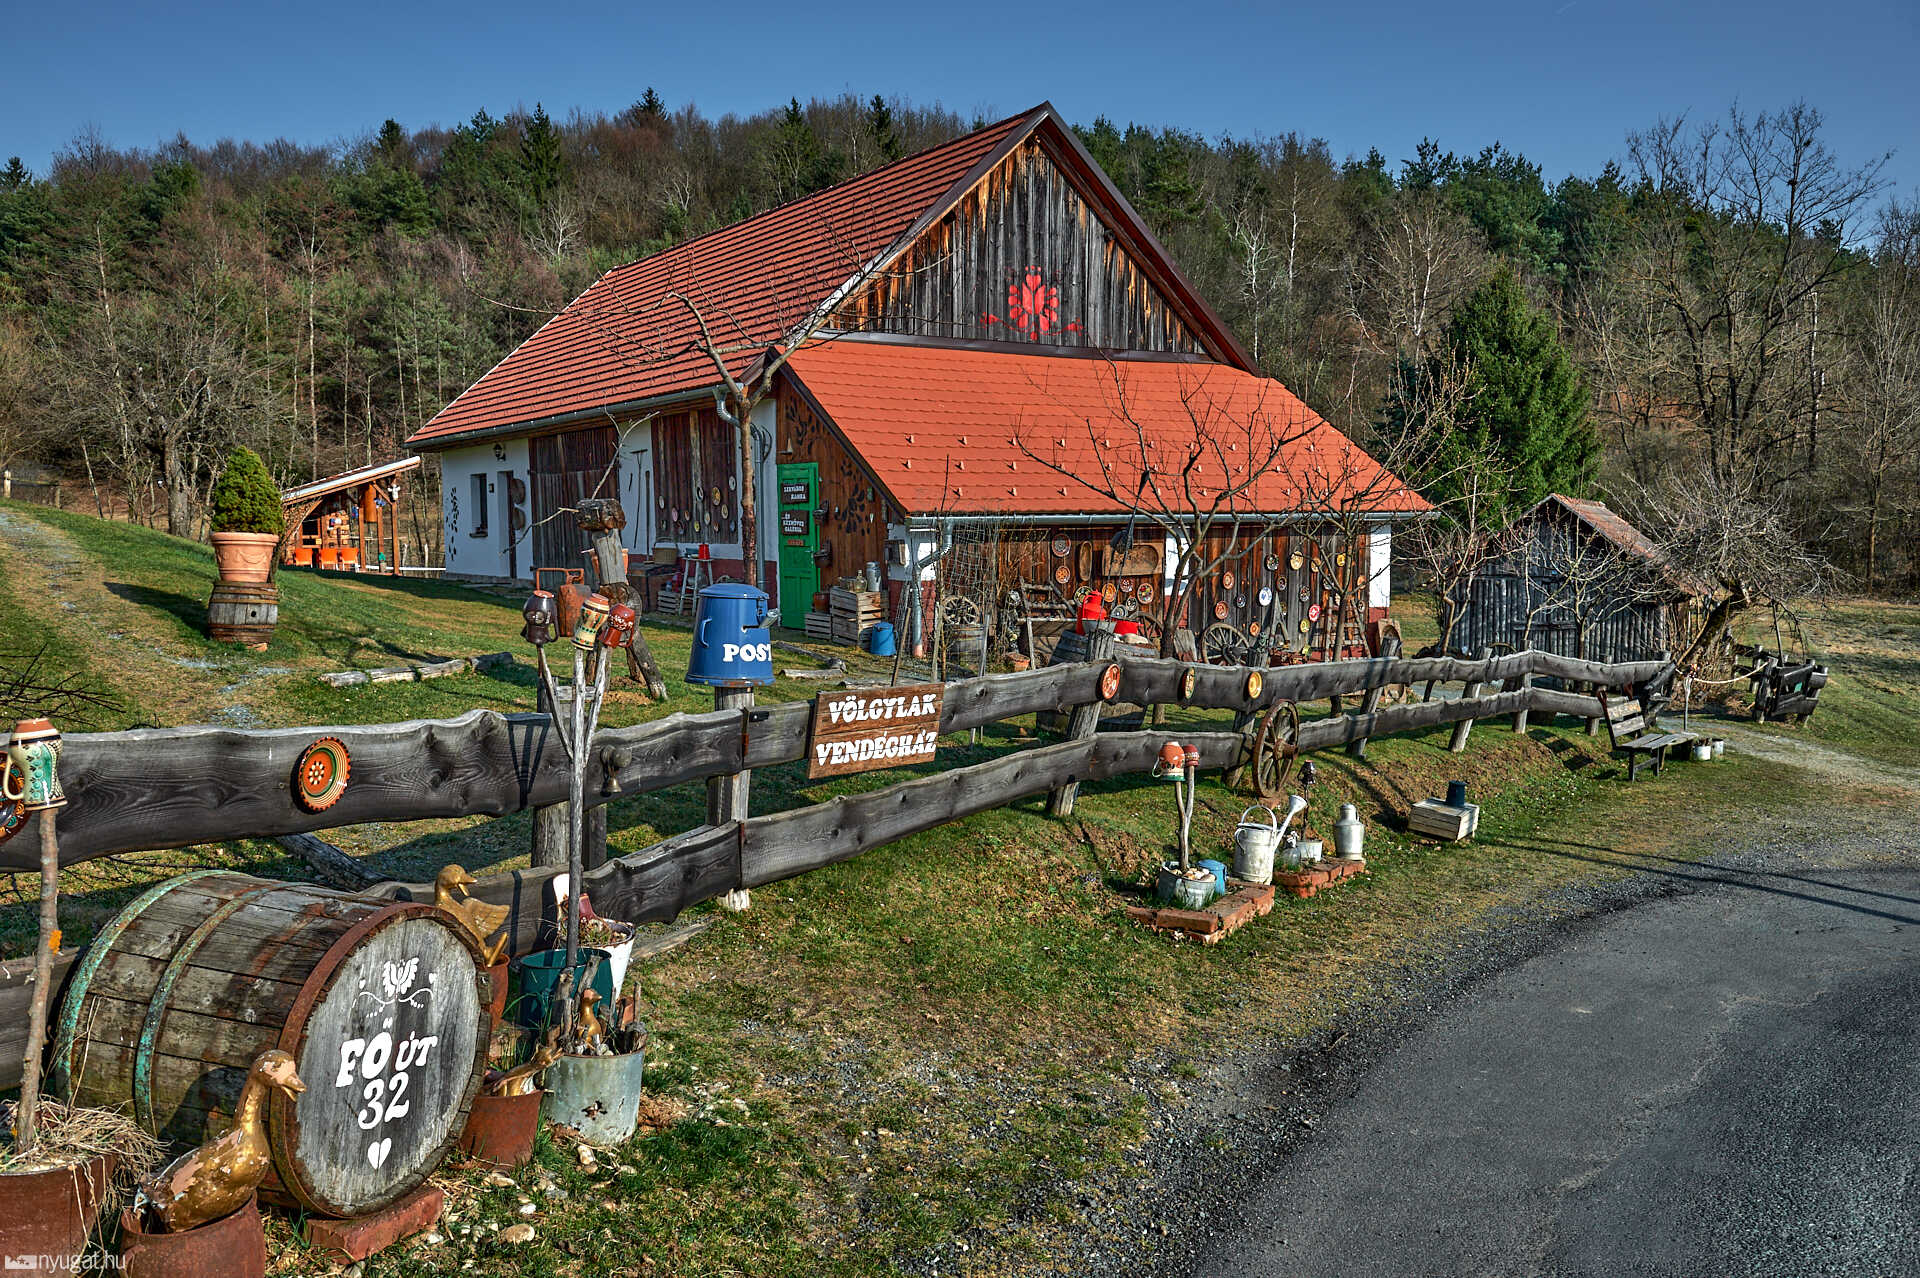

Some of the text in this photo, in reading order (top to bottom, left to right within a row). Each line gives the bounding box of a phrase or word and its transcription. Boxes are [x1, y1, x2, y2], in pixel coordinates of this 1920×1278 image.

[829, 694, 937, 724] VÖLGYLAK
[816, 729, 937, 766] VENDÉGHÁZ
[335, 1017, 438, 1088] FŐ ÚT
[358, 1071, 410, 1129] 32
